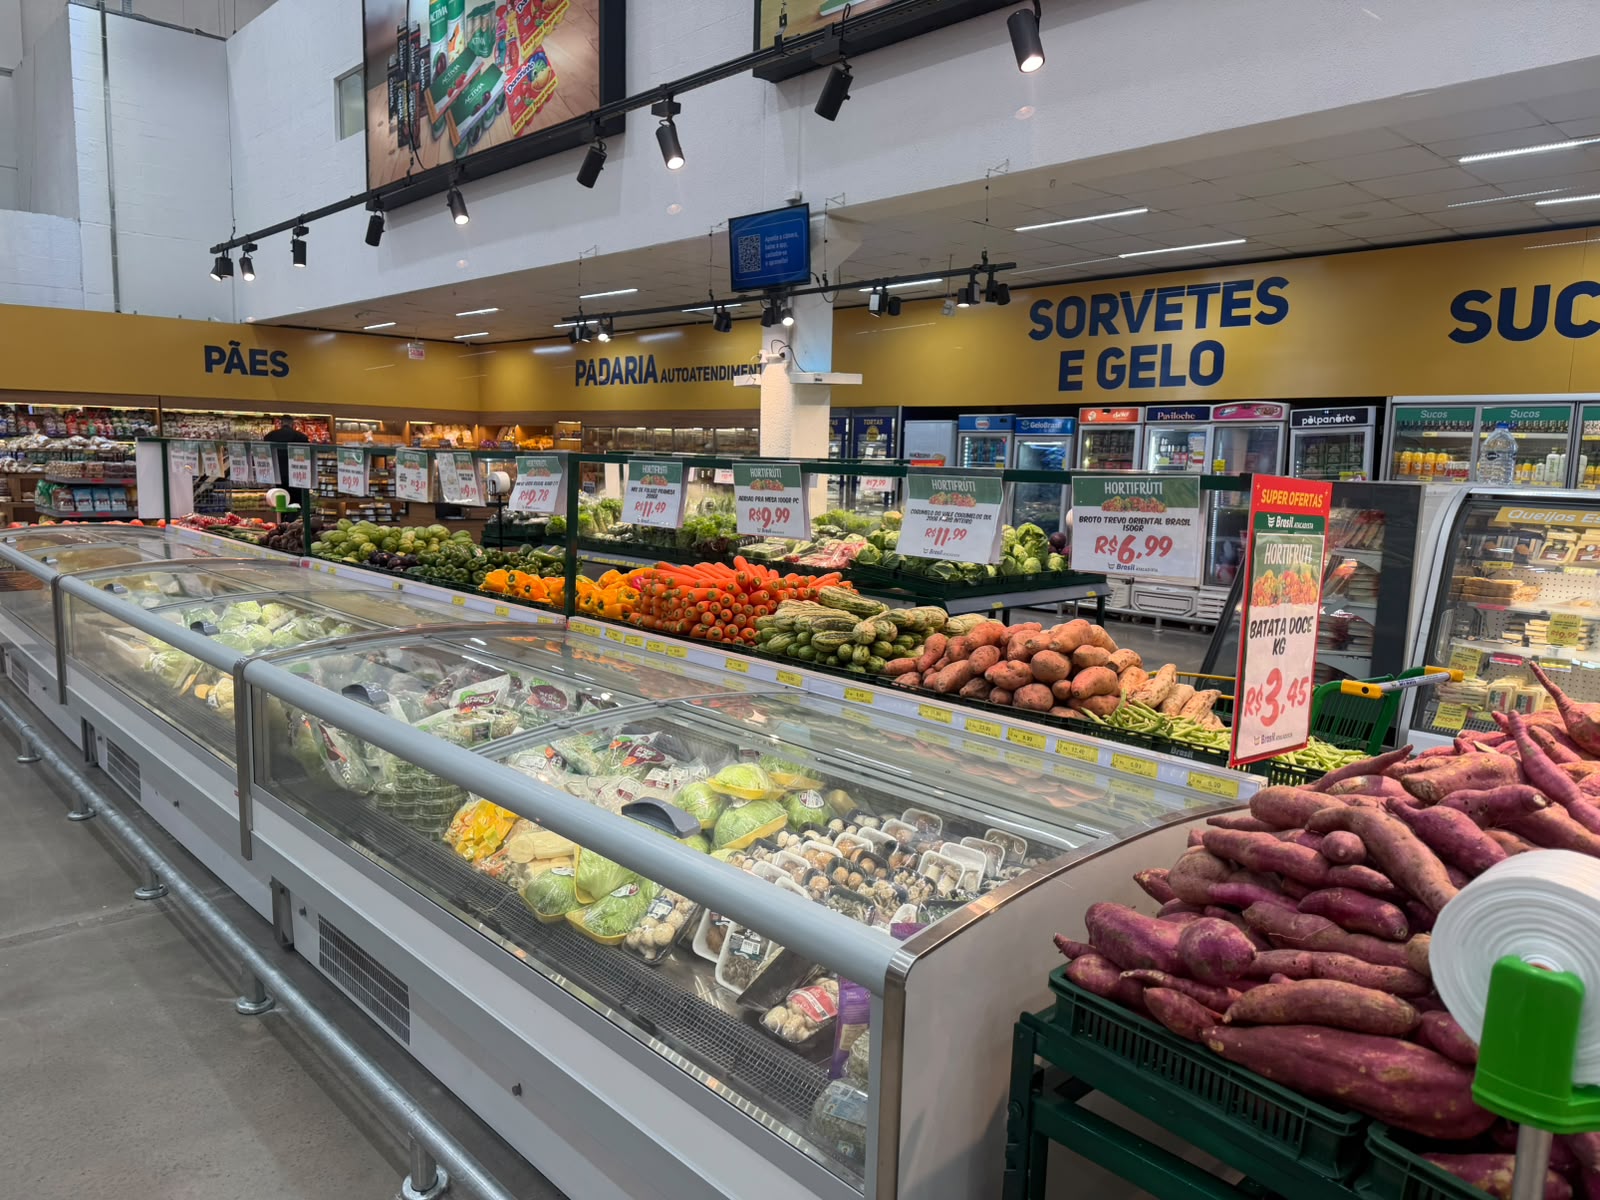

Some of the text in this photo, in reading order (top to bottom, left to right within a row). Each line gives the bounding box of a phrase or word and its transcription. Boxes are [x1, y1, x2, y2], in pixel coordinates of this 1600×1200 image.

[1028, 276, 1289, 341] SORVETES
[1448, 280, 1600, 344] SUC
[204, 339, 289, 378] PÃES
[1058, 339, 1225, 391] E GELO
[575, 354, 659, 387] PADARIA
[1420, 410, 1448, 419] Sucos
[1510, 409, 1540, 419] Sucos
[1261, 489, 1324, 508] SUPER OFERTAS
[635, 501, 667, 517] R$11,49
[748, 507, 790, 529] R$9,99
[1508, 509, 1577, 523] Queijos
[1104, 516, 1126, 524] TREVO
[1128, 517, 1163, 525] ORIENTAL
[1165, 518, 1191, 526] BRASIL
[1275, 515, 1294, 528] Brasil
[924, 526, 968, 546] R$11,99
[1094, 534, 1174, 564] R$6,99
[1250, 616, 1314, 639] BATATA DOCE
[1272, 637, 1286, 655] KG
[1244, 667, 1309, 727] R$3,45
[1170, 746, 1194, 759] Brasil
